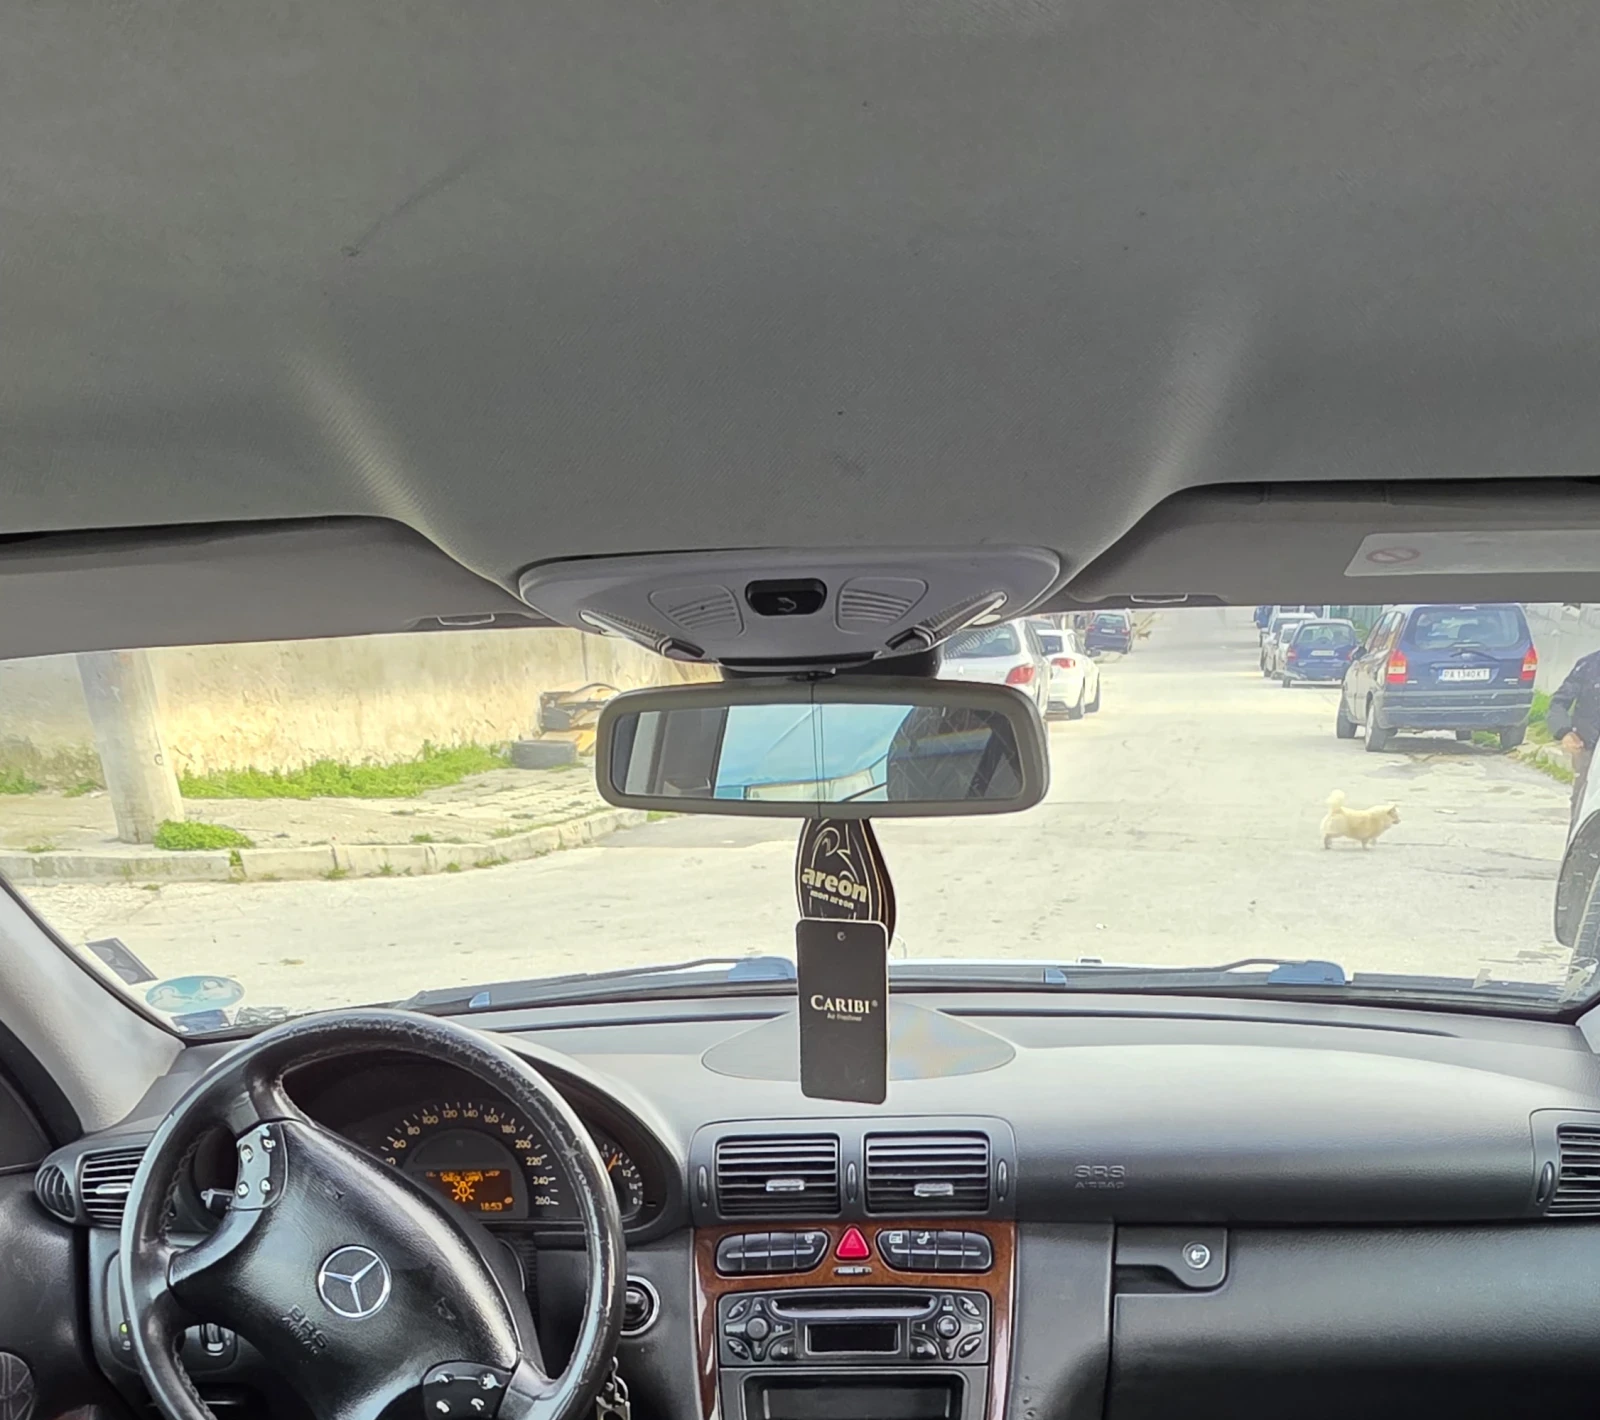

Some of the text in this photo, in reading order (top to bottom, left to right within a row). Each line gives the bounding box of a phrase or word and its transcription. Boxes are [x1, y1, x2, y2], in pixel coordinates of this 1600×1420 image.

[801, 868, 867, 903] areon
[811, 994, 870, 1014] CARIBI
[442, 1109, 458, 1118] 120
[462, 1109, 478, 1118] 140
[422, 1115, 439, 1124] 100
[484, 1114, 499, 1124] 160
[407, 1126, 420, 1135] 80
[501, 1124, 517, 1134] 180
[393, 1139, 407, 1149] 60
[515, 1139, 532, 1149] 200
[526, 1156, 542, 1166] 220
[1075, 1164, 1125, 1178] SRS
[532, 1176, 549, 1185] 240
[535, 1195, 551, 1205] 260
